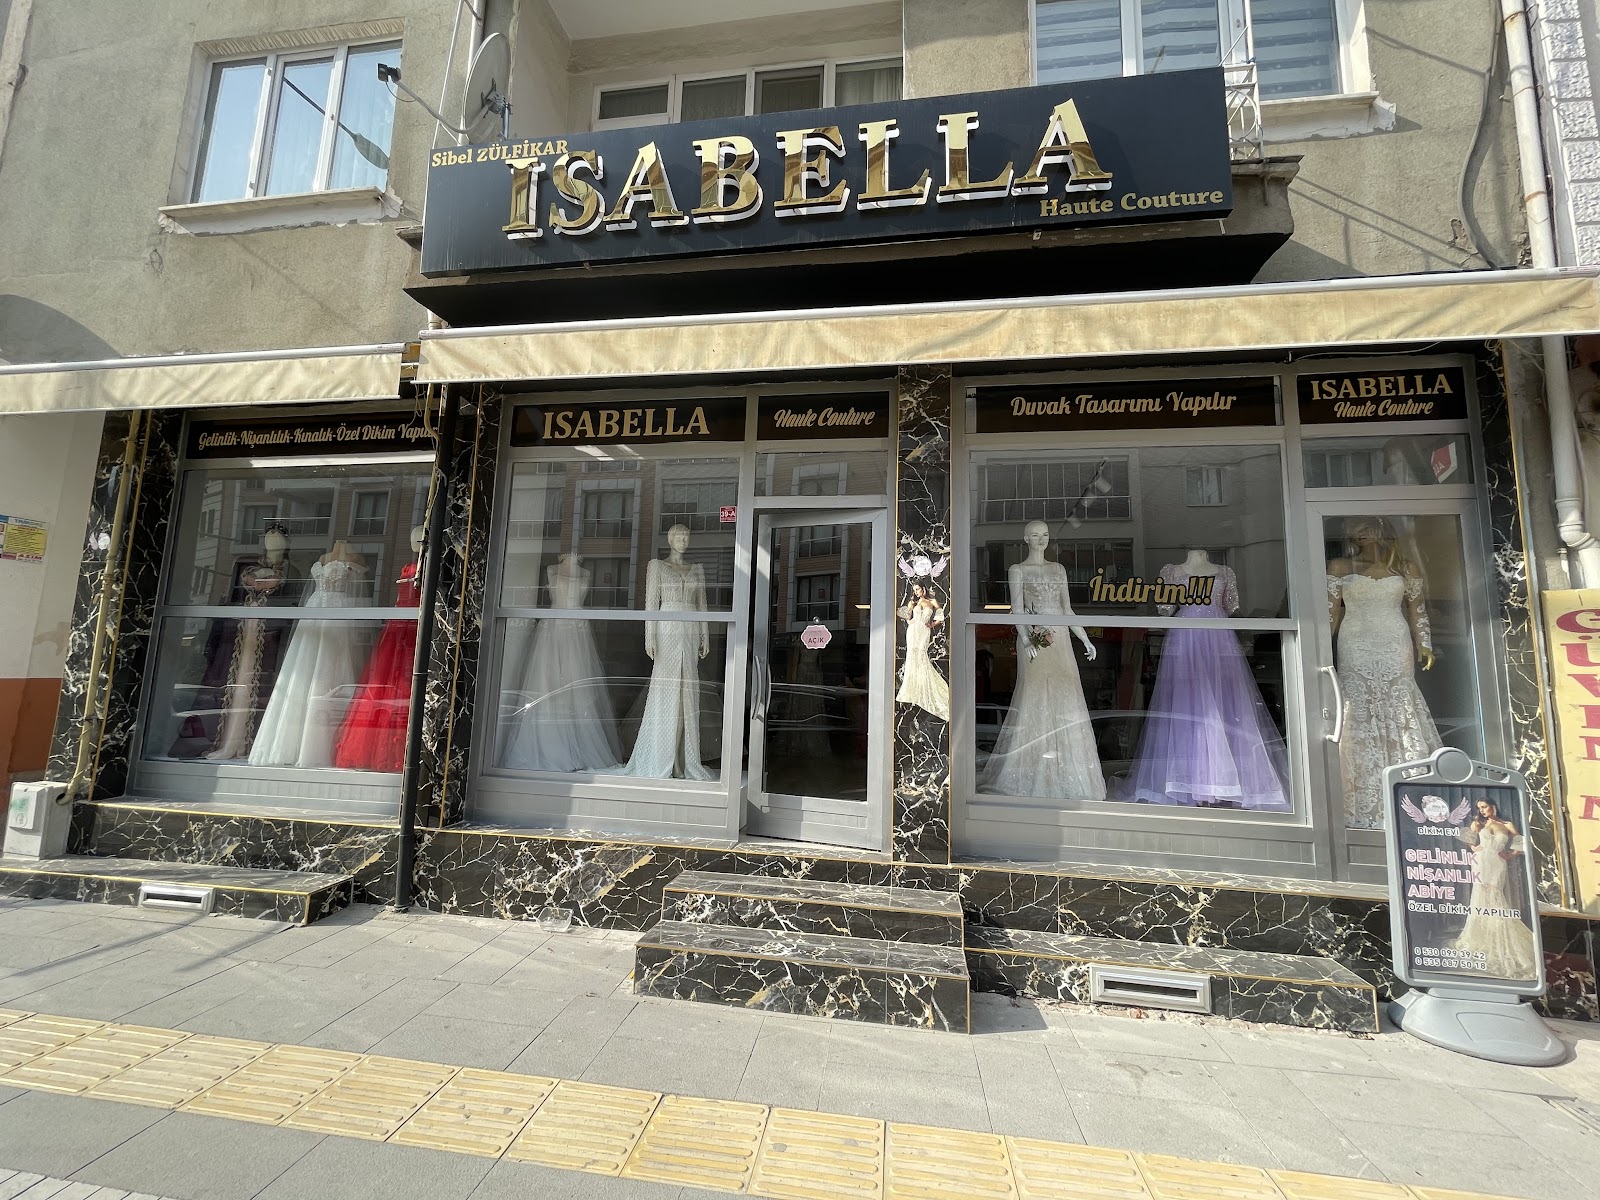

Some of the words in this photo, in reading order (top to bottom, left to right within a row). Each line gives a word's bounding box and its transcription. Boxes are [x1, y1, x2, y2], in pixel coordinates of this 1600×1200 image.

[432, 149, 473, 167] Sibel
[477, 140, 569, 162] ZÜLFİKAR
[502, 98, 1113, 240] ISABELLA
[1040, 198, 1114, 218] Haute
[1120, 190, 1224, 211] Couture
[1310, 374, 1454, 400] ISABELLA
[1010, 396, 1071, 416] Duvak
[1075, 394, 1163, 414] Tasarımı
[1166, 391, 1237, 416] Yapılır
[1333, 400, 1376, 418] Haute
[1377, 399, 1434, 416] Couture
[542, 406, 710, 439] ISABELLA
[774, 409, 817, 428] Haute
[817, 406, 875, 427] Couture
[362, 424, 396, 440] Dikim
[1089, 567, 1215, 605] İndirim!!!
[808, 636, 824, 645] AÇIK
[1417, 825, 1444, 836] DİKİM
[1445, 826, 1461, 837] EVİ
[1405, 847, 1479, 866] GELİNLİK
[1406, 864, 1483, 884] NİŞANLIK
[1407, 883, 1456, 900] ABİYE
[1408, 900, 1437, 914] ÖZEL
[1439, 902, 1472, 915] DİKİM
[1475, 907, 1522, 920] YAPILIR
[1414, 946, 1422, 956] 0
[1422, 947, 1440, 957] 530
[1440, 948, 1458, 958] 099
[1460, 949, 1472, 959] 39
[1473, 951, 1486, 961] 42
[1414, 957, 1422, 966] 0
[1423, 957, 1441, 967] 535
[1441, 959, 1459, 968] 687
[1460, 960, 1473, 970] 50
[1475, 961, 1487, 971] 18
